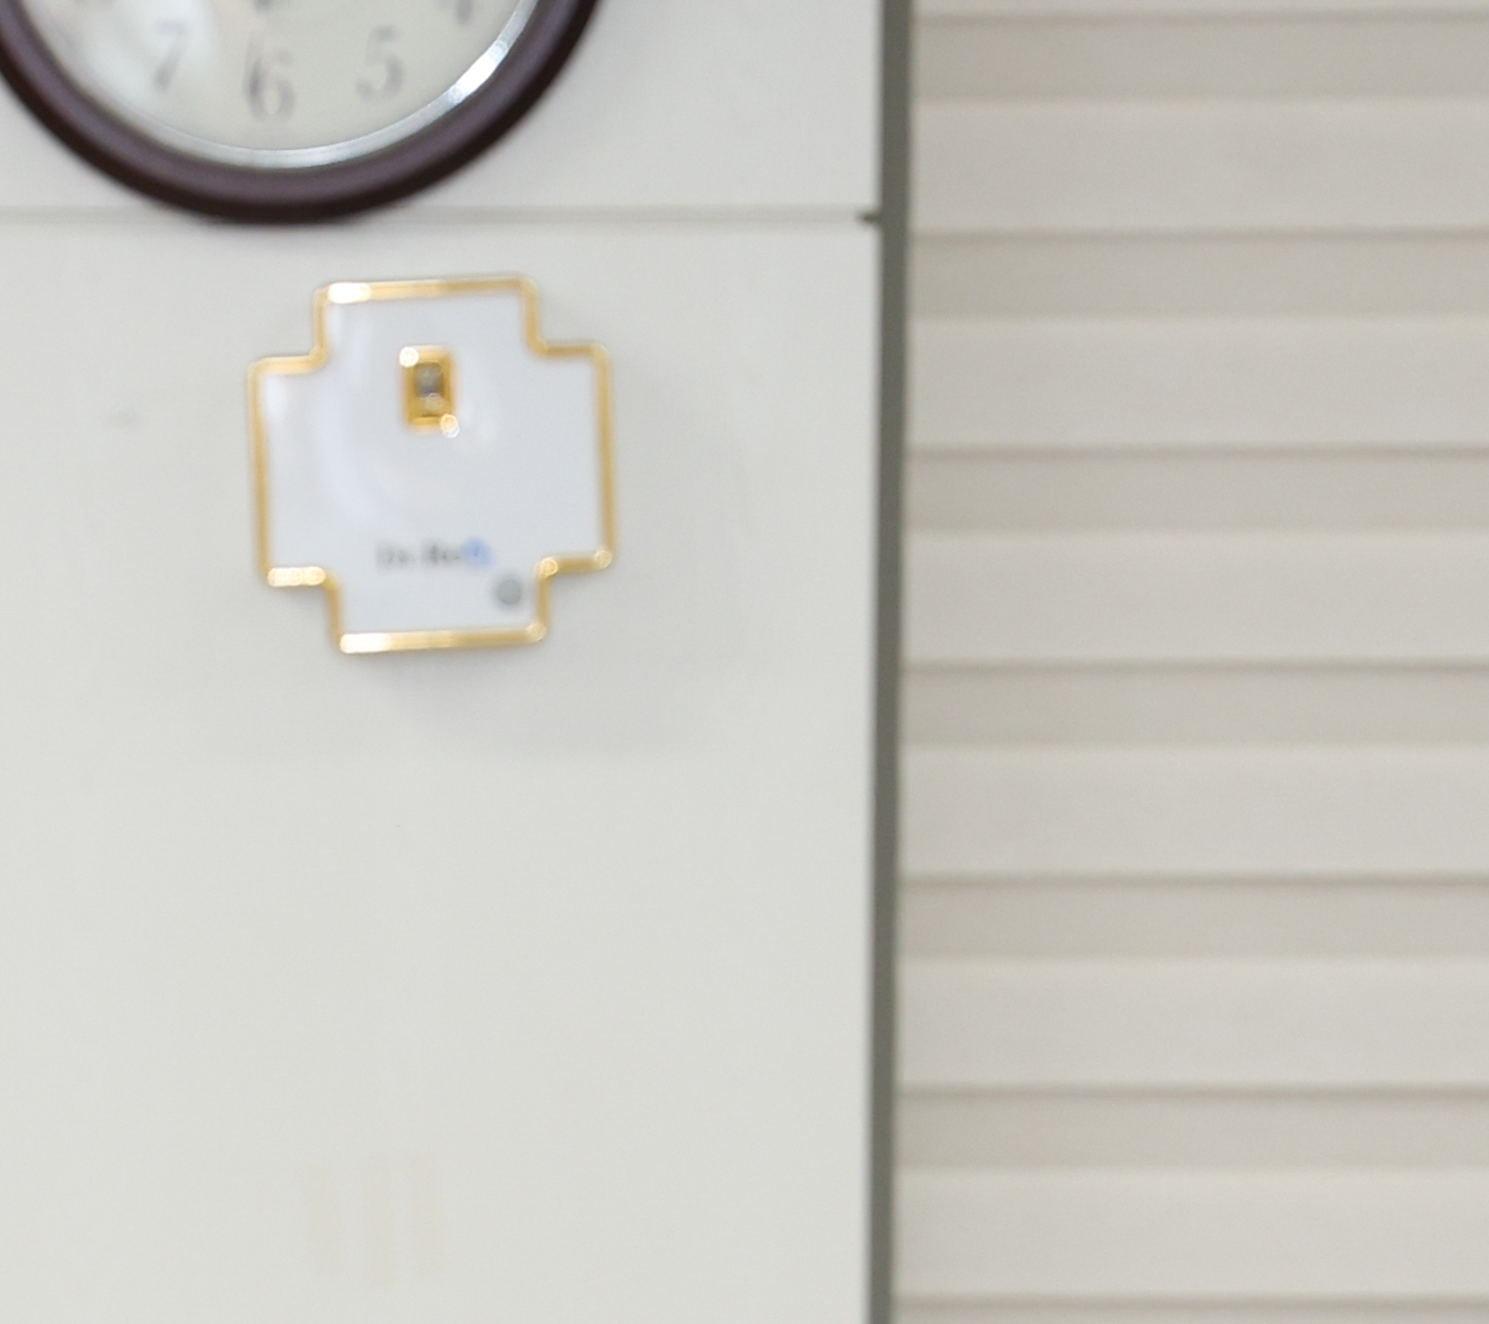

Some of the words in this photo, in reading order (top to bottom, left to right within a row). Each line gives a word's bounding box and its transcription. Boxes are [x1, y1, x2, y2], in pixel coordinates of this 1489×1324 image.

[151, 18, 190, 93] 7
[243, 30, 297, 123] 6
[355, 22, 406, 101] 5
